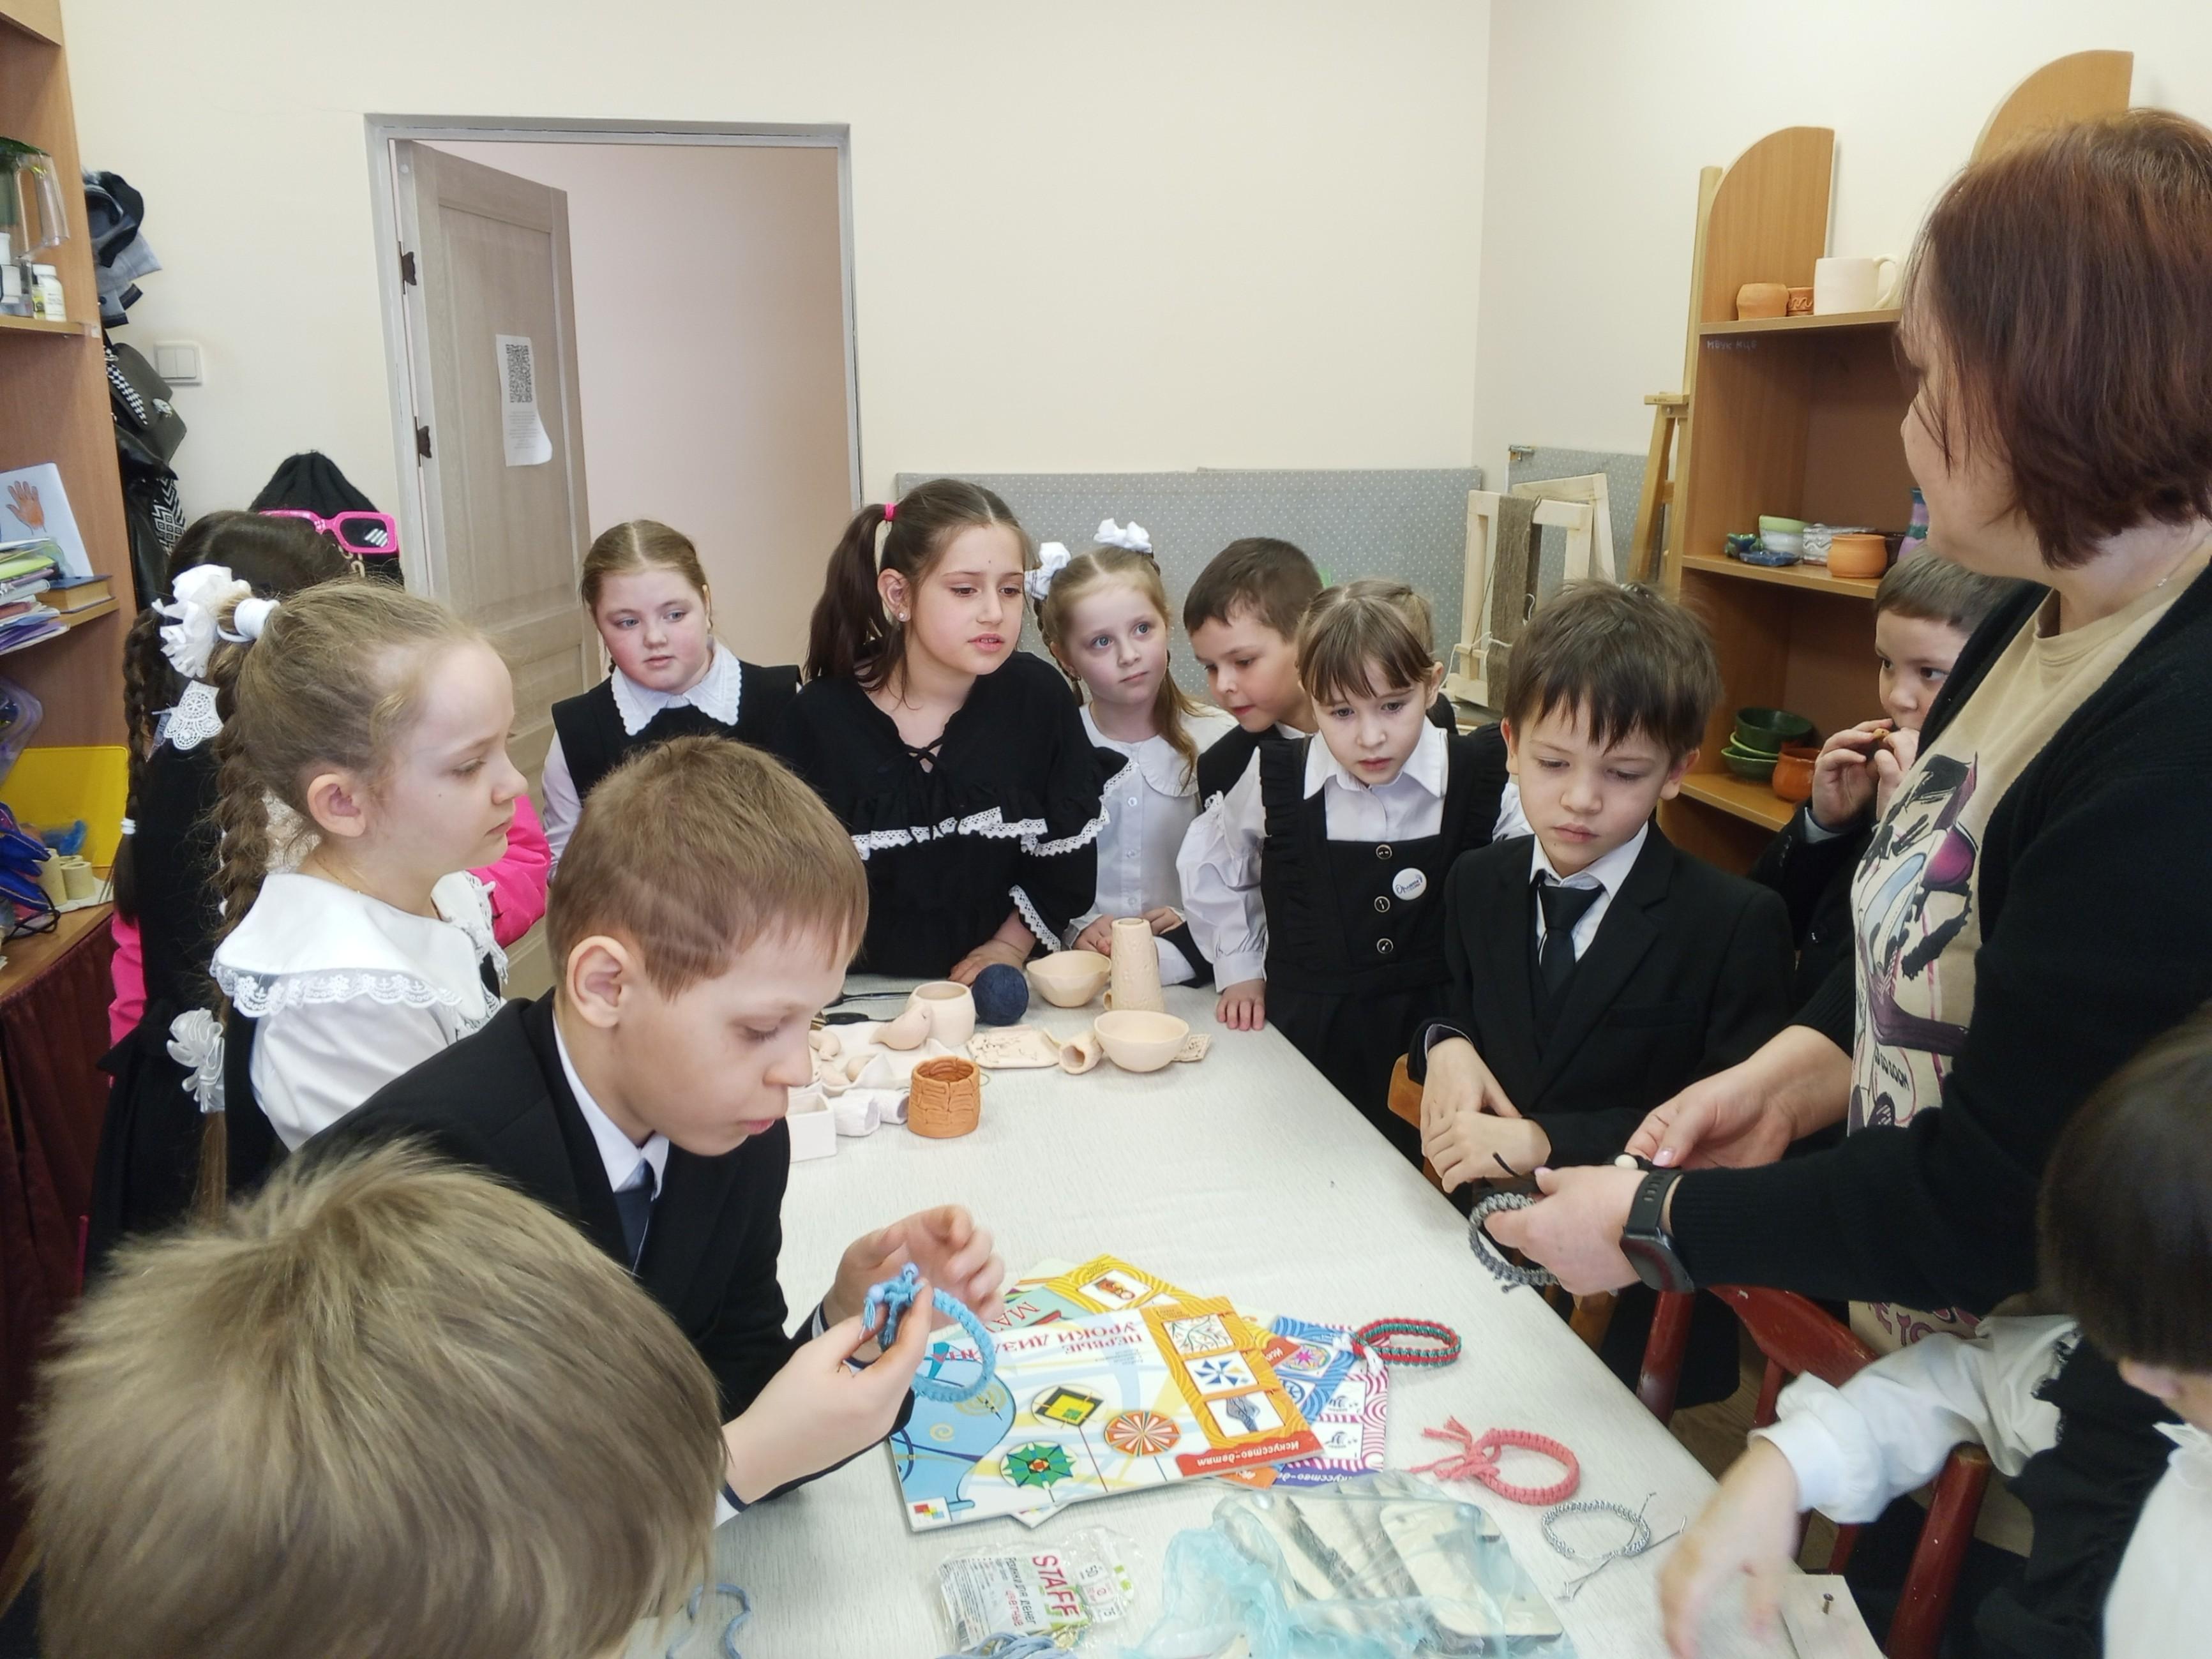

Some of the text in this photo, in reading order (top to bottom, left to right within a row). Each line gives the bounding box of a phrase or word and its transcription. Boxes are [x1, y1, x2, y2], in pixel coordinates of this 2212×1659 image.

[931, 1321, 1135, 1365] УРОКИ ДИЗЙНА
[1065, 1333, 1143, 1355] ПЕРВЫЕ
[1033, 1555, 1079, 1617] STAFF
